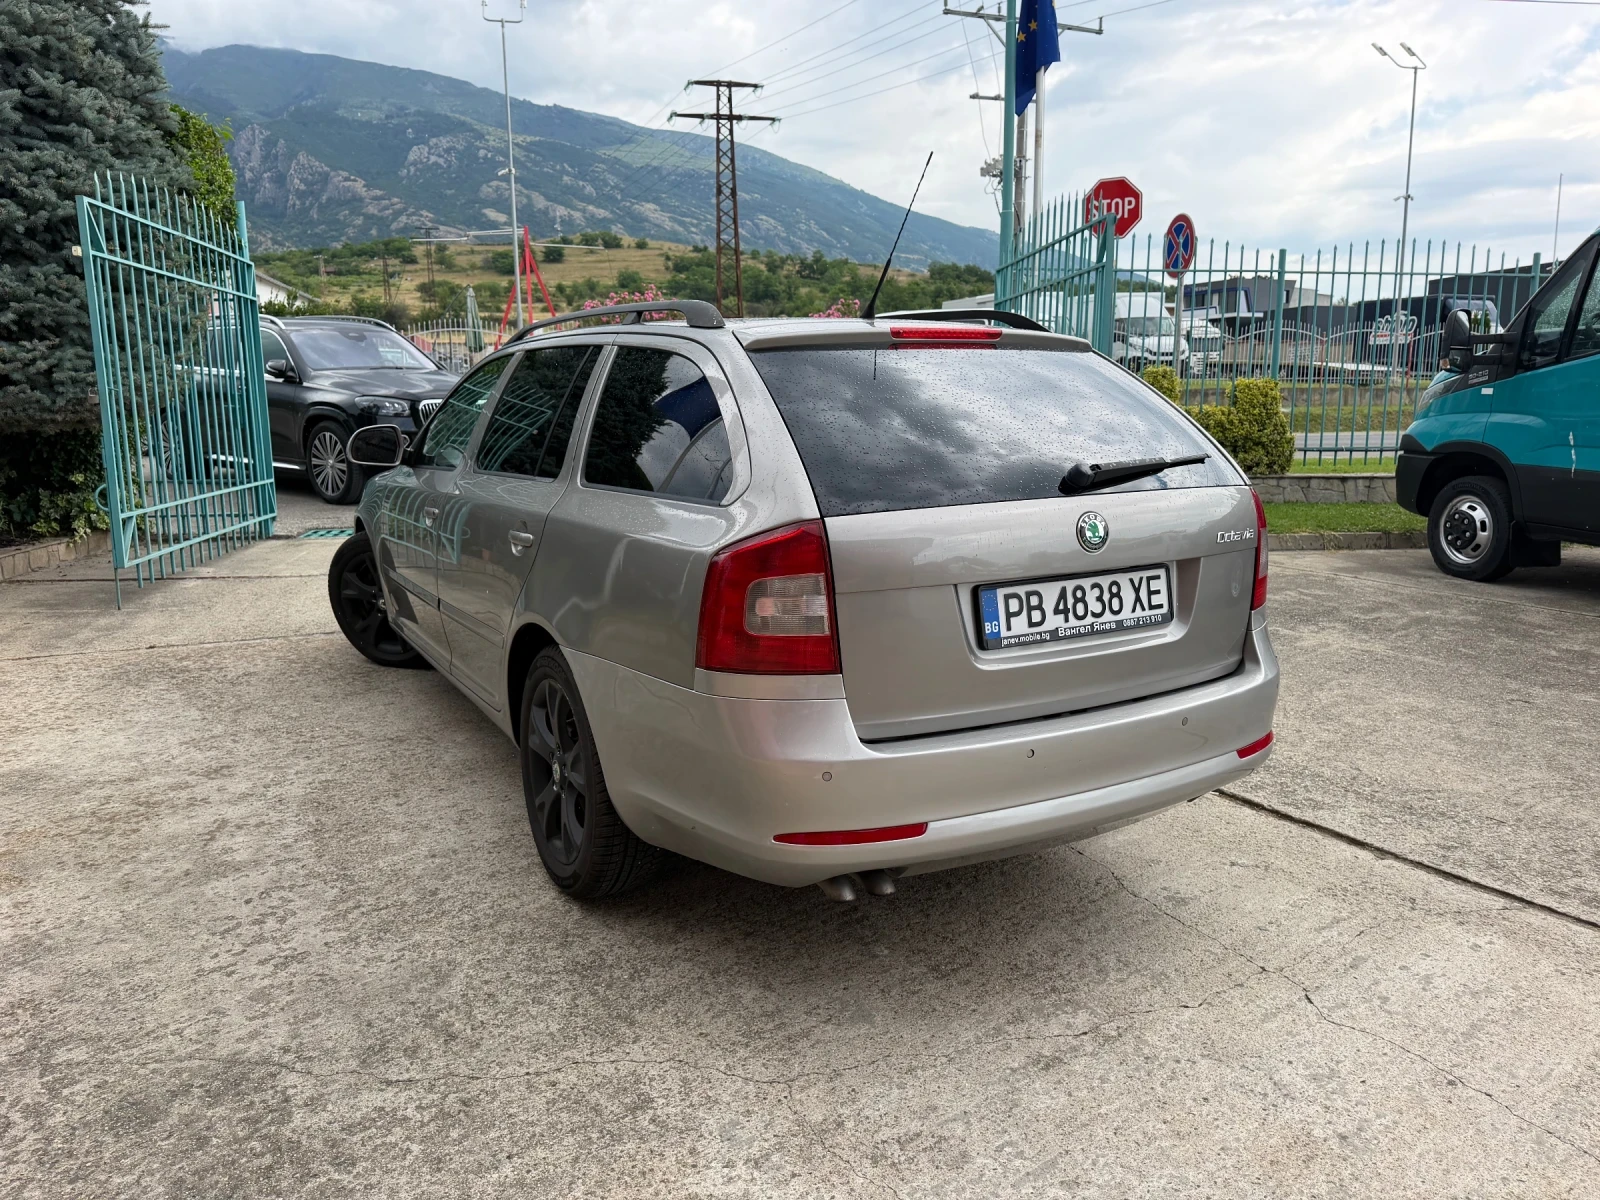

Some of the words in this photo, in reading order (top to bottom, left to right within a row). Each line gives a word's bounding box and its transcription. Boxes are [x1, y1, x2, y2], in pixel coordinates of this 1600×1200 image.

[1088, 197, 1136, 221] STOP
[1216, 527, 1255, 543] Octavia
[1003, 589, 1047, 633] PB
[1053, 580, 1124, 624] 4838
[1128, 574, 1164, 614] XE
[984, 620, 999, 635] BG
[1058, 625, 1091, 637] Вангел
[1093, 621, 1117, 632] Янев
[1001, 632, 1050, 647] janev.mobile.bg
